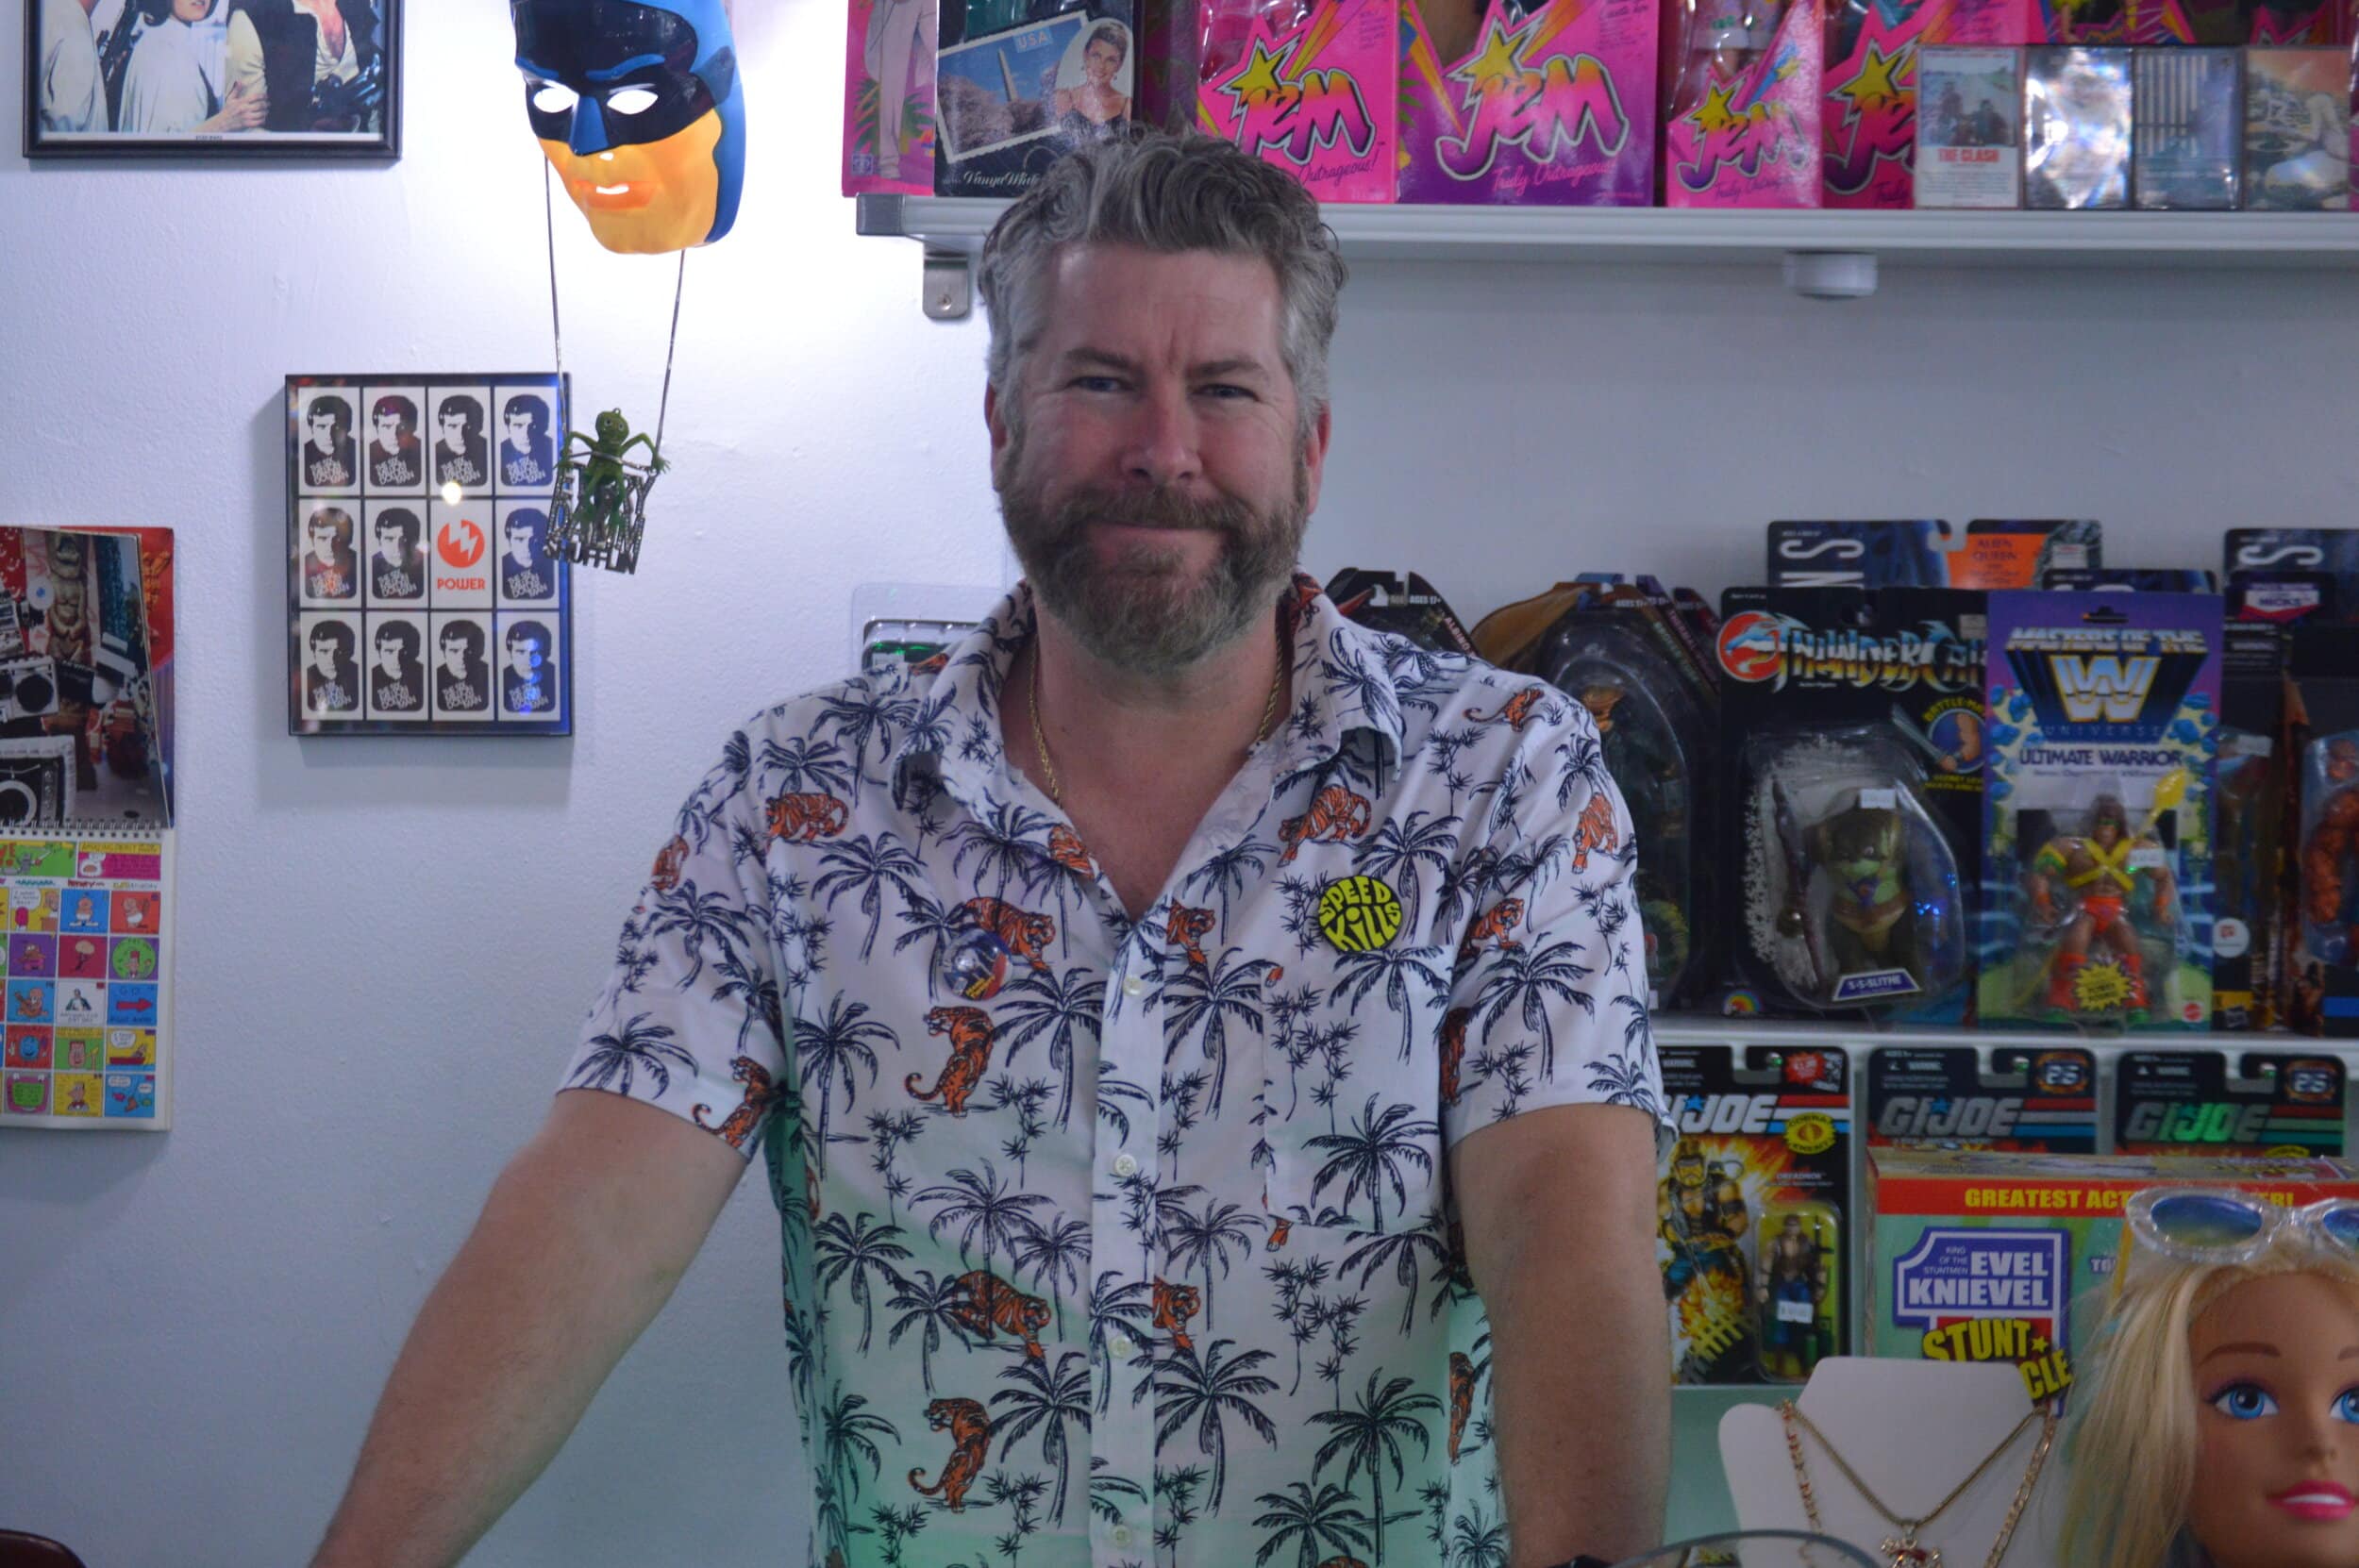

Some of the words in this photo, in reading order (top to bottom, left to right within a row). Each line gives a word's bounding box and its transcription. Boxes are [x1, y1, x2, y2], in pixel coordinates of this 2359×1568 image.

[1019, 31, 1047, 48] USA
[1937, 148, 1958, 161] THE
[1960, 148, 1999, 162] CLASH
[437, 578, 485, 591] POWER
[1443, 616, 1472, 653] ALBINO
[2005, 628, 2117, 653] MASTERS
[2119, 630, 2152, 653] OF
[2154, 630, 2208, 654] THE
[2019, 749, 2089, 767] ULTIMATE
[2099, 750, 2183, 768] WARRIOR
[1319, 876, 1392, 926] SPEED
[2045, 1064, 2082, 1086] 25
[2293, 1073, 2329, 1095] 25
[1965, 1188, 2081, 1209] GREATEST
[2085, 1190, 2131, 1209] ACT
[1939, 1258, 1950, 1267] OF
[1952, 1258, 1969, 1267] THE
[1946, 1246, 1967, 1259] KING
[1925, 1267, 1969, 1277] STUNTMEN
[1971, 1252, 2049, 1277] EVEL
[1909, 1278, 2049, 1307] KNIEVEL
[1921, 1318, 2031, 1364] STUNT
[2017, 1349, 2073, 1402] CLE
